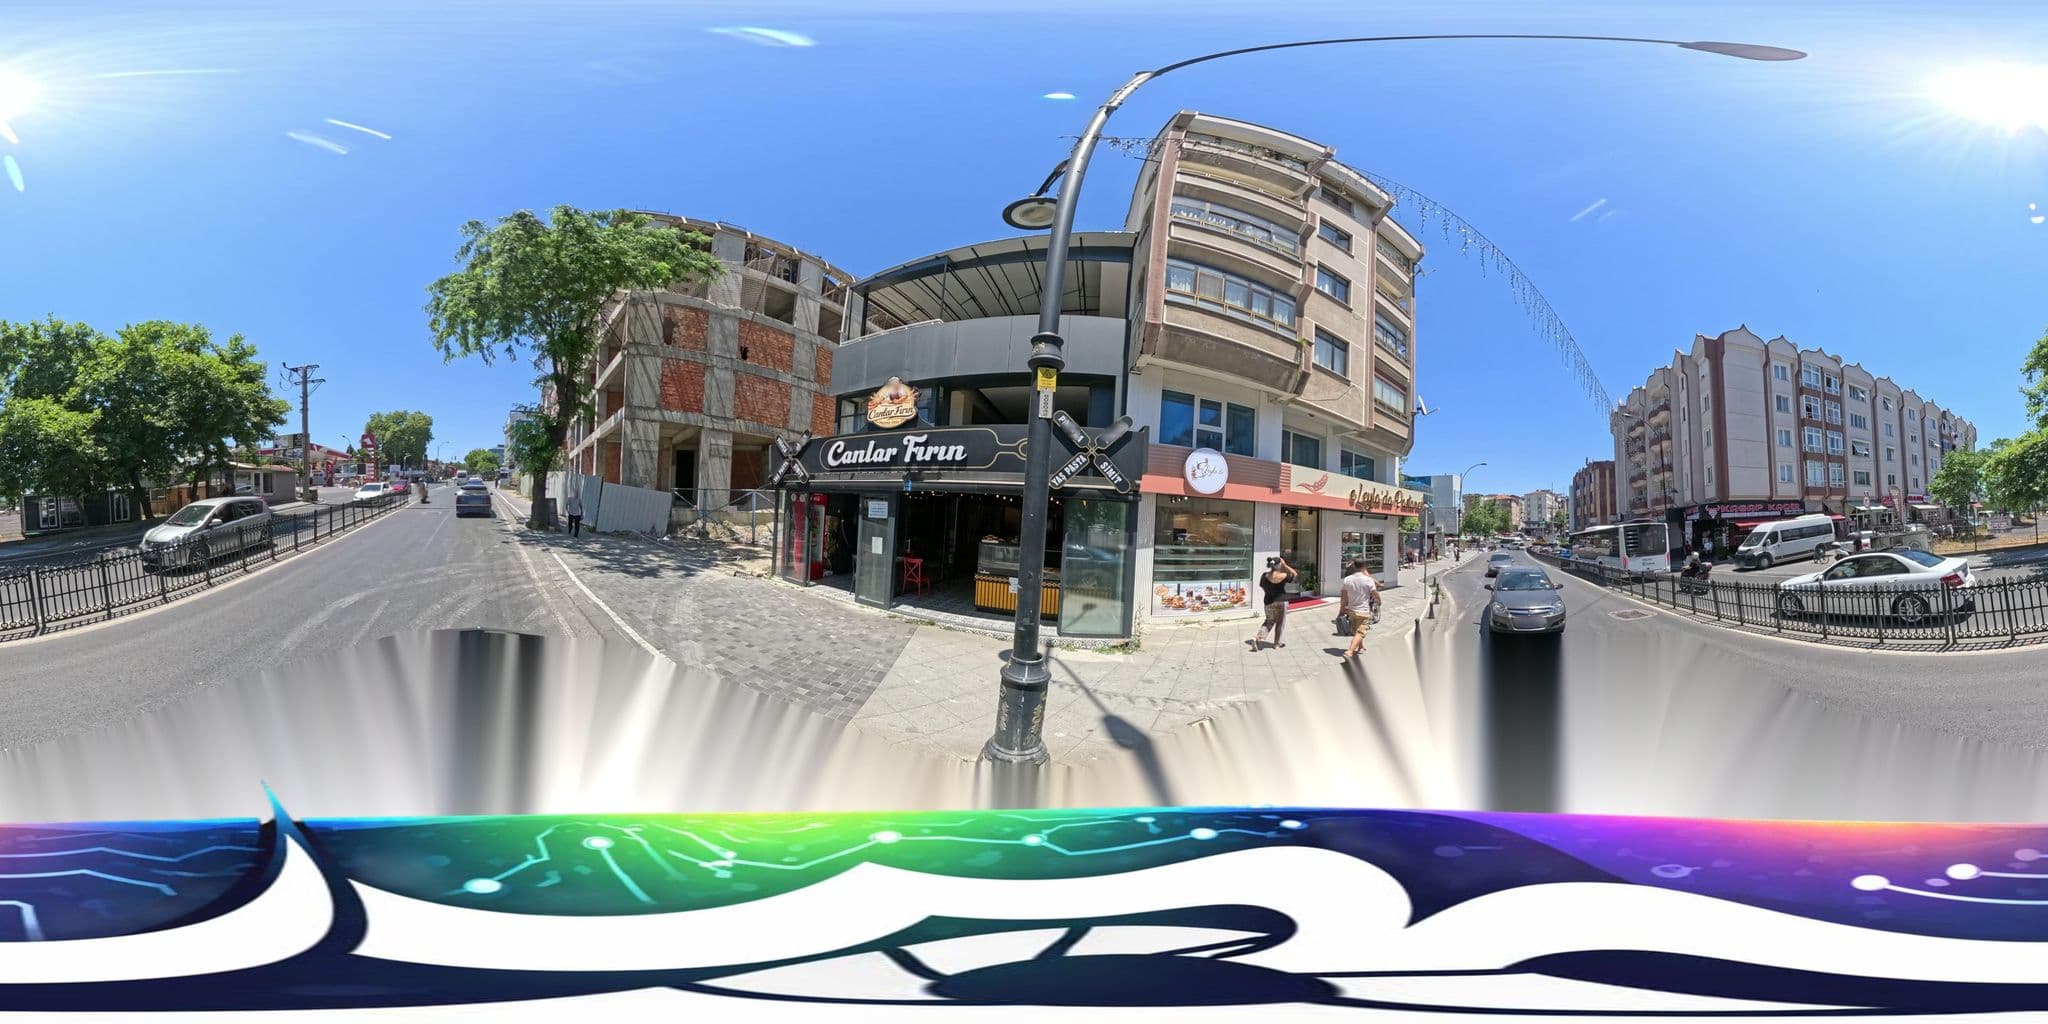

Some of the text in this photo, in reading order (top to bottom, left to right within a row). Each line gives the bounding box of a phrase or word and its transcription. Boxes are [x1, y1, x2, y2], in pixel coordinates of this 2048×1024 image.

[827, 433, 968, 467] Canlar Fırın
[1064, 454, 1087, 476] PASTA
[1100, 461, 1122, 484] SİMİT
